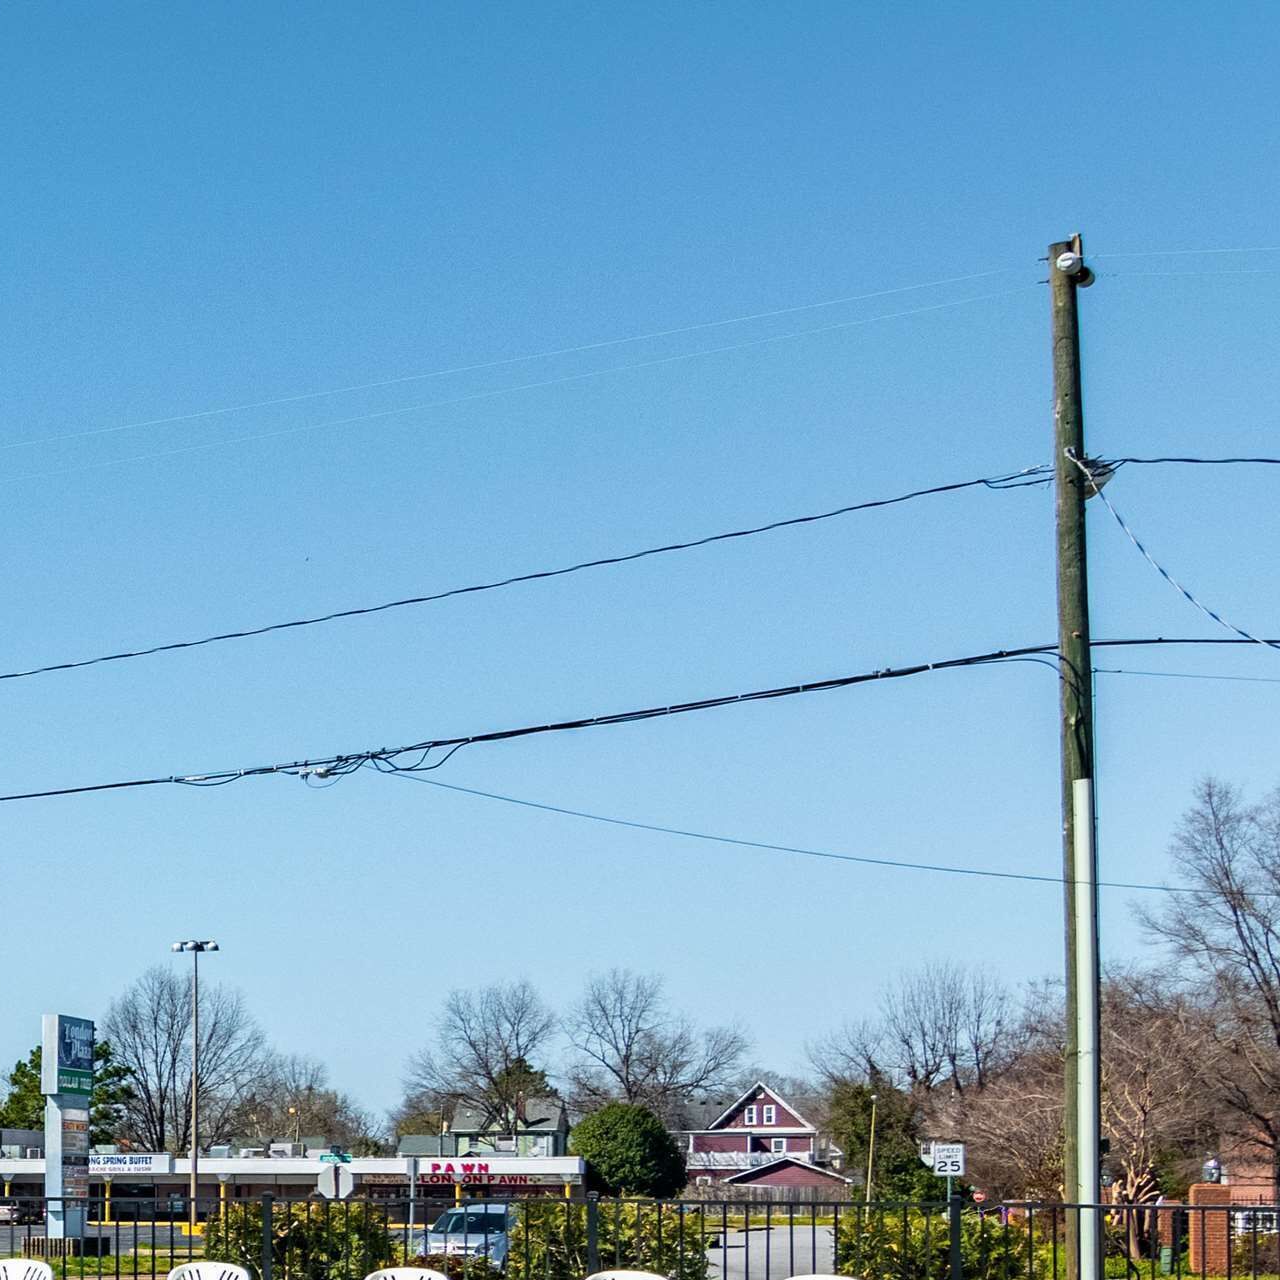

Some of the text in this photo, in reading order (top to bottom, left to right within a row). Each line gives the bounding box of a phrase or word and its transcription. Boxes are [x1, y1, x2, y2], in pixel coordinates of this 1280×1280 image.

[431, 1163, 489, 1173] PAWN
[937, 1161, 961, 1172] 25
[487, 1175, 528, 1184] PAWN
